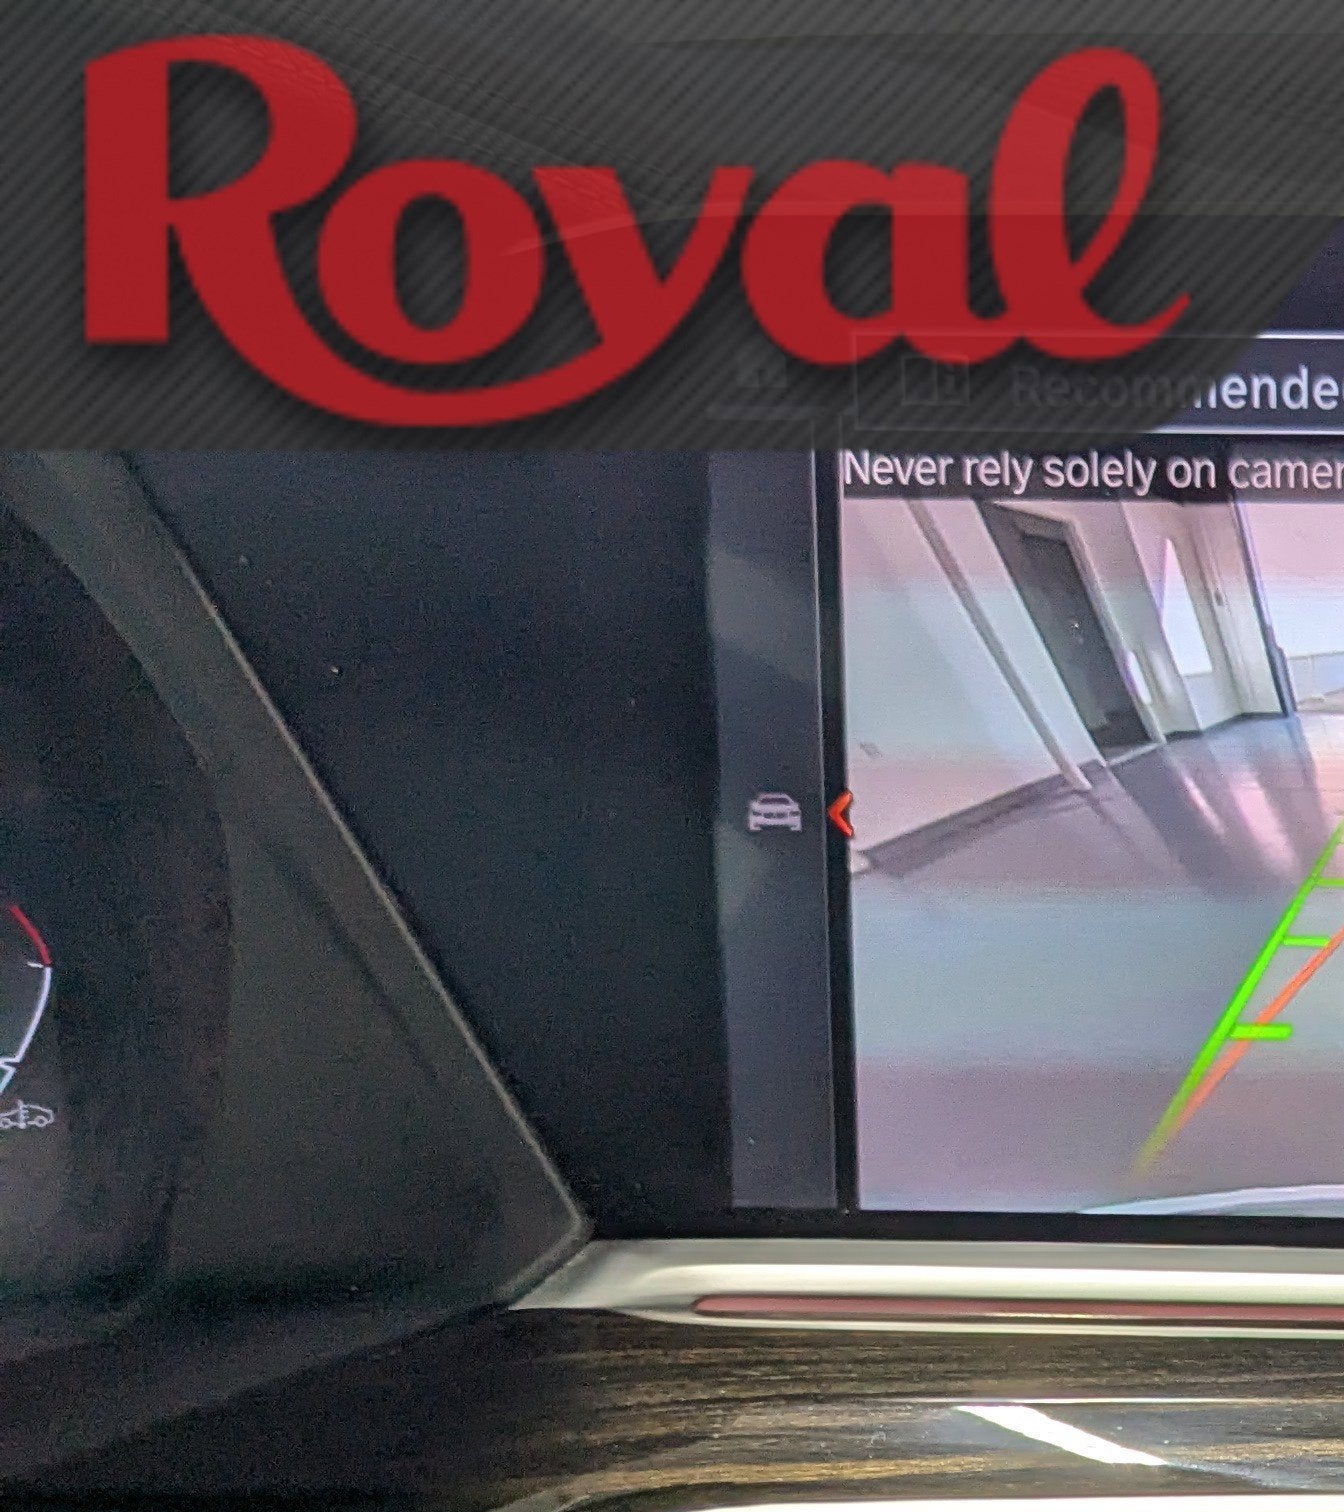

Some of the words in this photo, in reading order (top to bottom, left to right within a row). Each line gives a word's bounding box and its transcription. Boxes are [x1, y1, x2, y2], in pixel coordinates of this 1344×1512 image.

[843, 450, 952, 489] Never
[962, 449, 1032, 496] rely
[1043, 449, 1157, 497] solely
[1167, 458, 1217, 489] on
